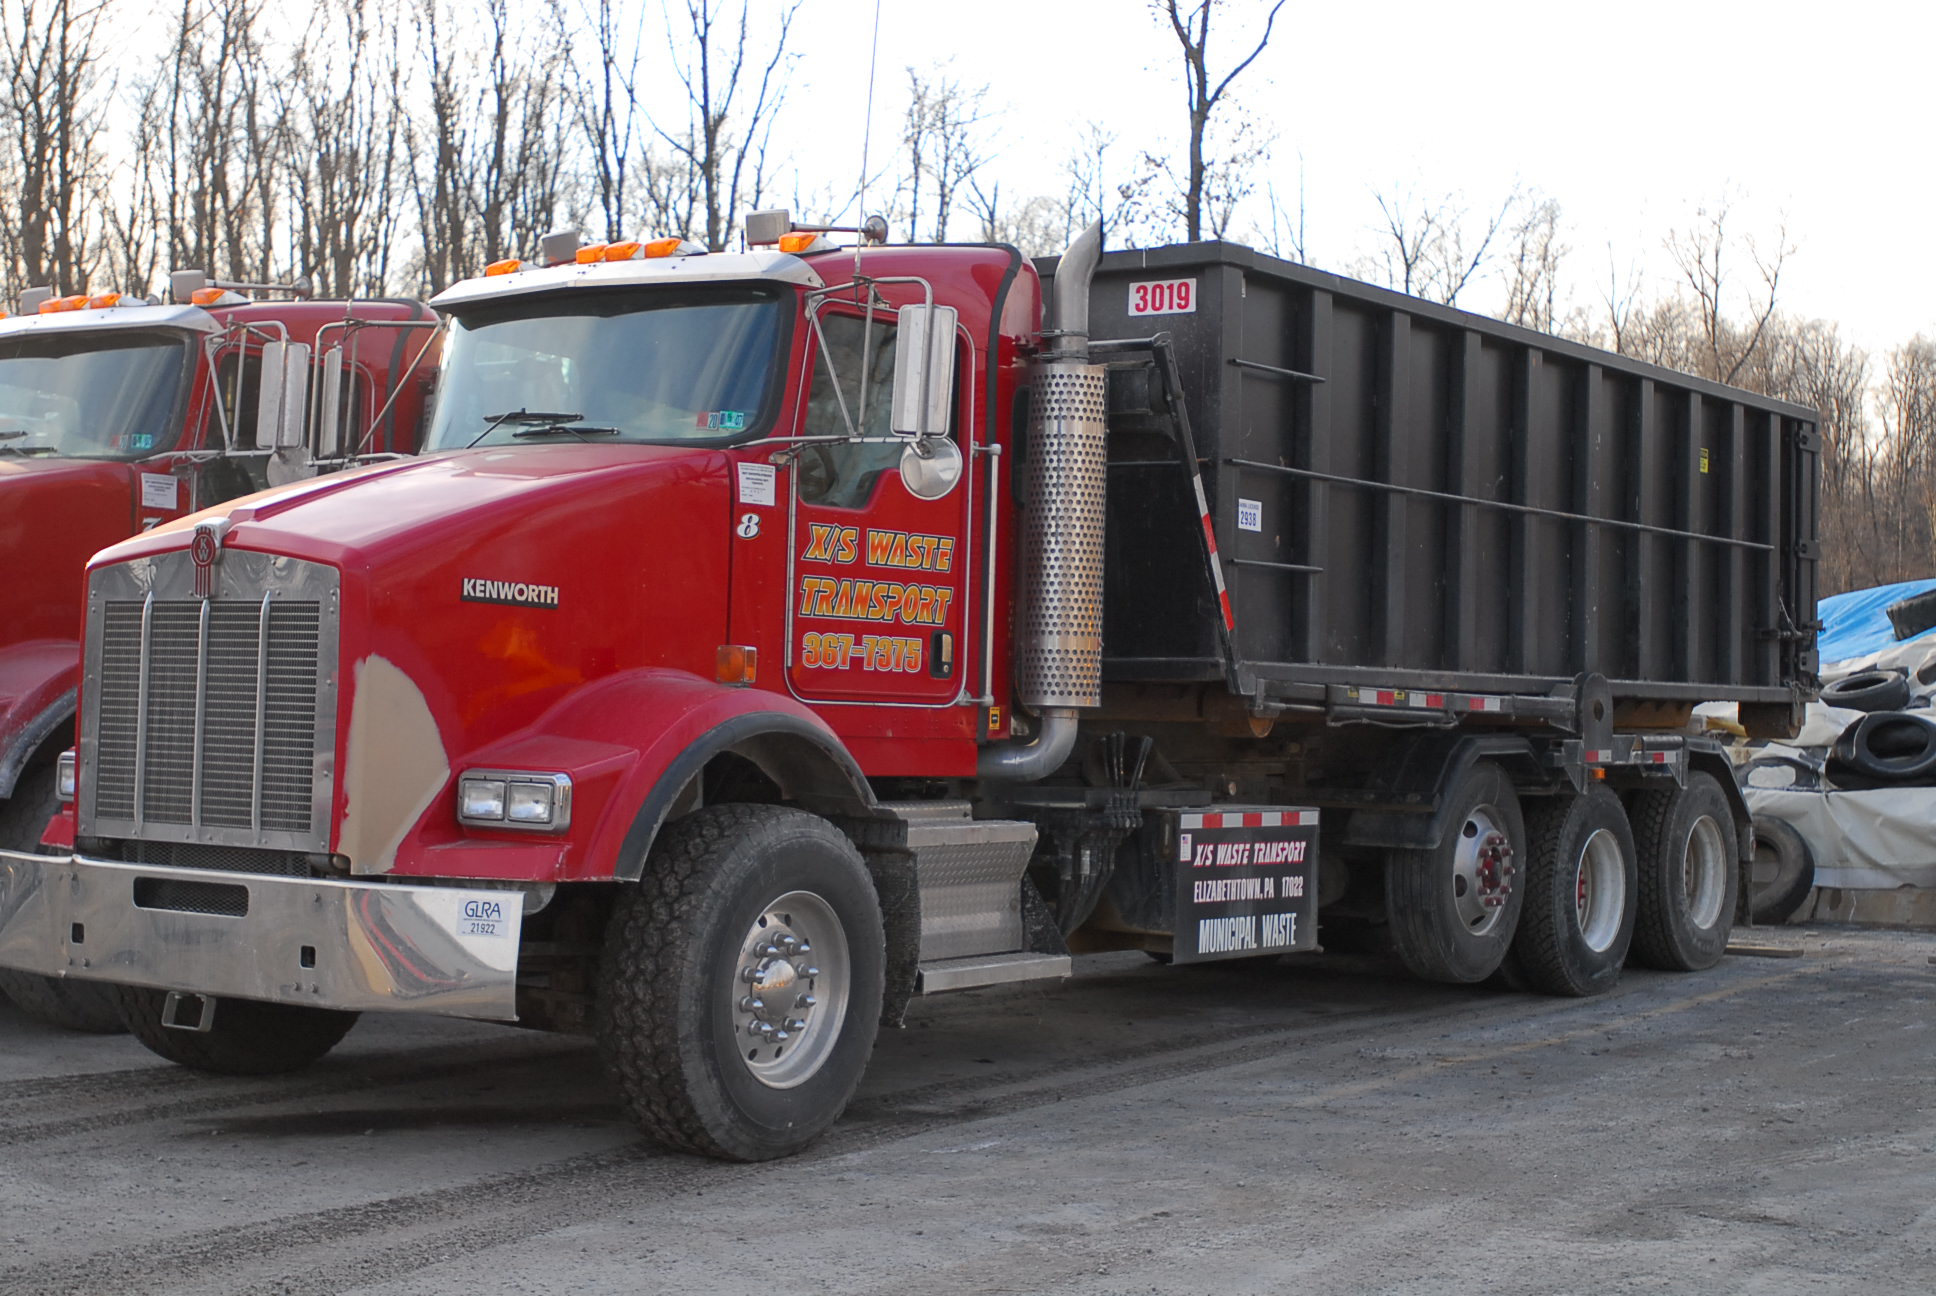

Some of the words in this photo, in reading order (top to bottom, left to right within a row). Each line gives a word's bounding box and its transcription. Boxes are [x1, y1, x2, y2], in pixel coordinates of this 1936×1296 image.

[1135, 281, 1191, 313] 3019
[737, 513, 761, 539] 8
[1240, 510, 1257, 527] 2938
[801, 522, 859, 564] X/S
[866, 528, 955, 572] WASTE
[463, 577, 559, 605] KENWORTH
[798, 575, 953, 626] TRANSPORT
[802, 632, 923, 673] 367-7375
[1193, 843, 1214, 867] X/S
[1216, 843, 1251, 866] WASTE
[1253, 841, 1307, 865] TRANSPORT
[1281, 875, 1304, 898] 17022
[465, 901, 500, 919] GLRA
[471, 923, 495, 934] 21922
[1198, 915, 1257, 954] MUNICIPAL
[1262, 912, 1297, 948] WASTE
